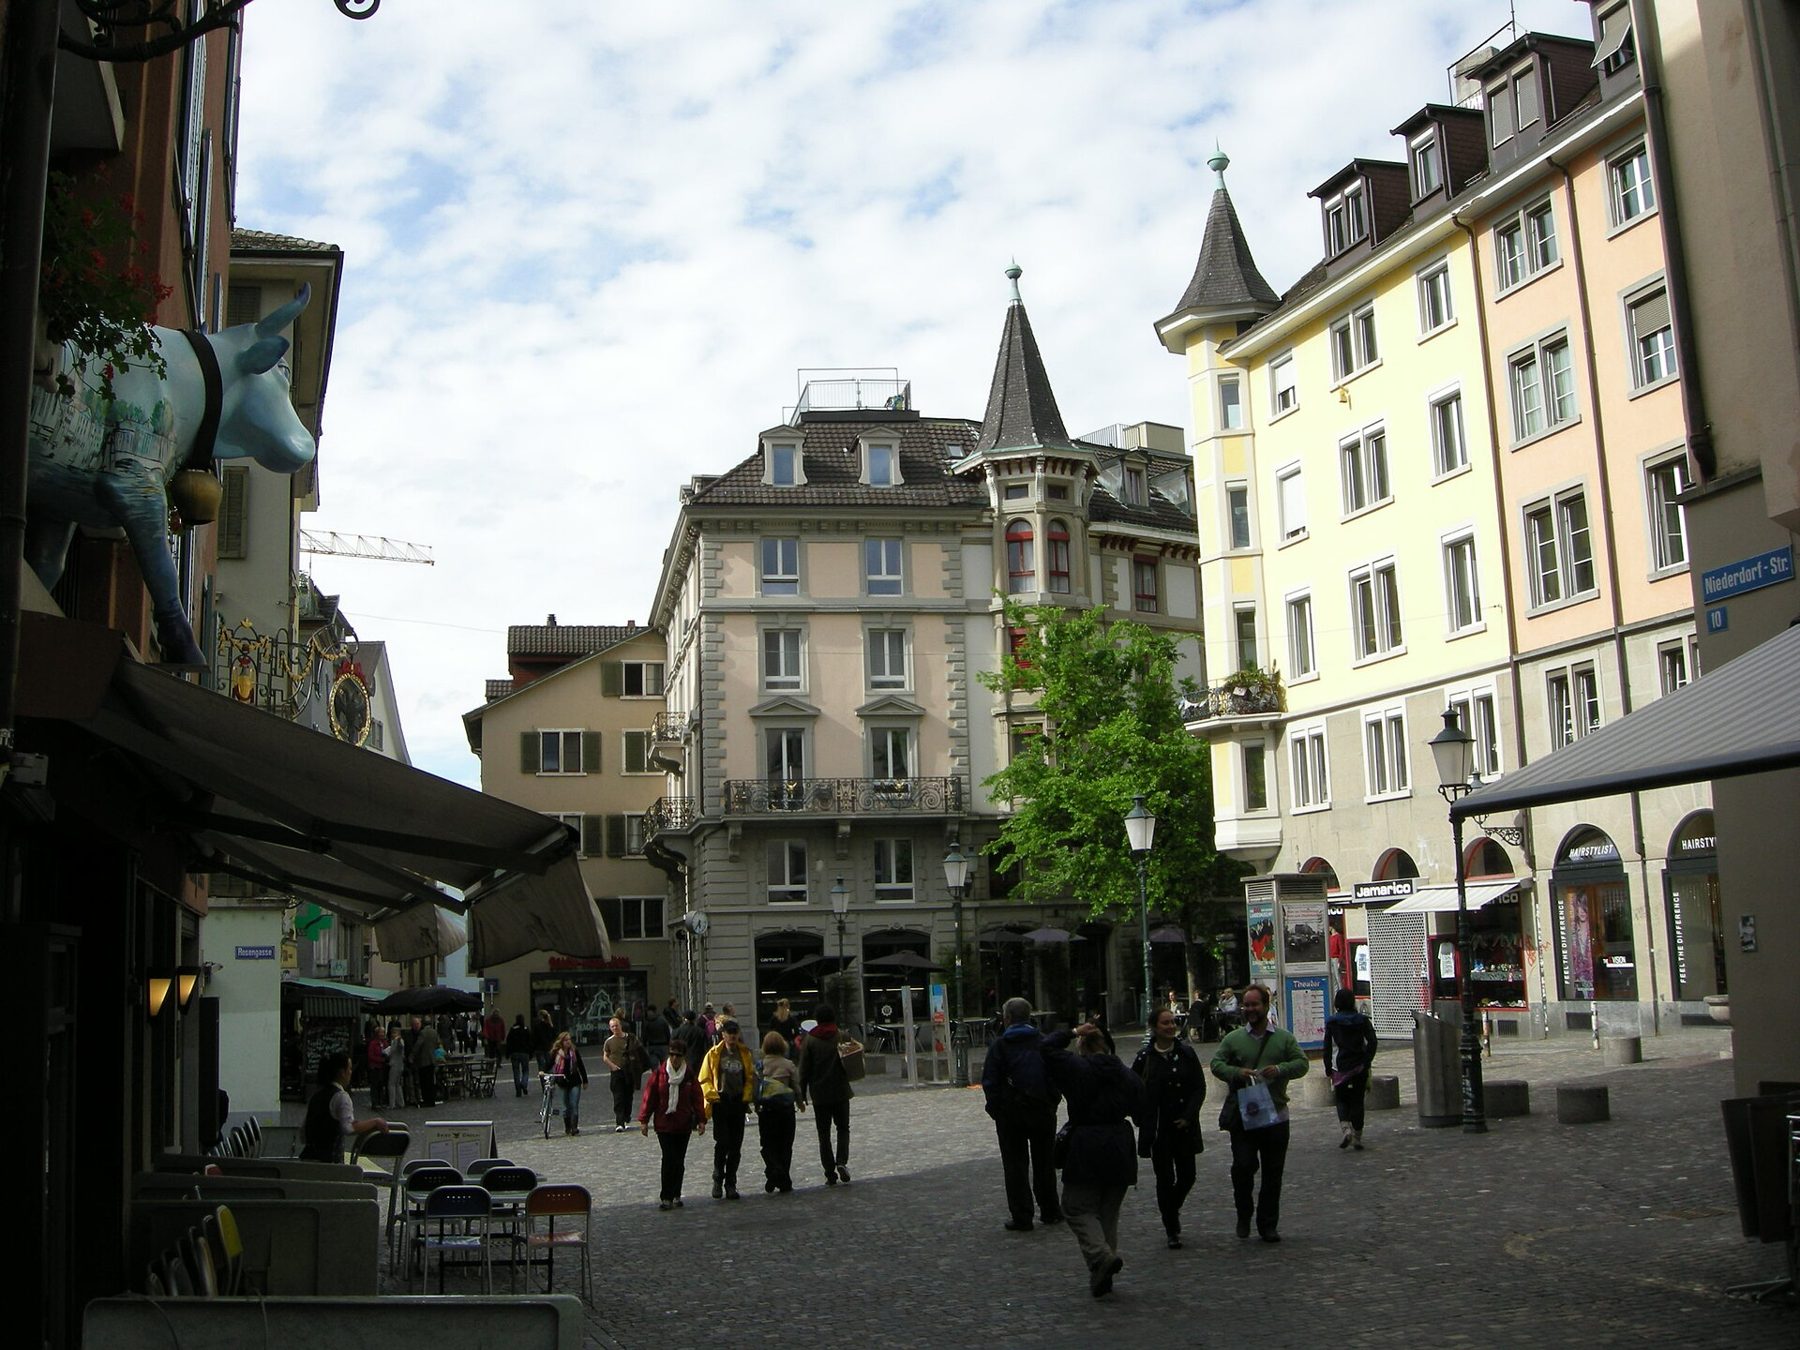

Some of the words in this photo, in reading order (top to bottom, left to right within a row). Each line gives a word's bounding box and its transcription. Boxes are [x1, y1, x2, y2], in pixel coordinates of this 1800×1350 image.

[1711, 611, 1722, 628] 10
[1569, 844, 1614, 857] HAIRSTYLIST
[1682, 837, 1717, 850] HAIRSTY
[1356, 882, 1411, 898] Jamarico
[1557, 900, 1568, 948] DIFFERENCE
[1672, 892, 1684, 944] DIFFERENCE
[237, 947, 273, 959] Rosengasse
[1677, 945, 1685, 961] THE
[1679, 963, 1687, 984] FEEL
